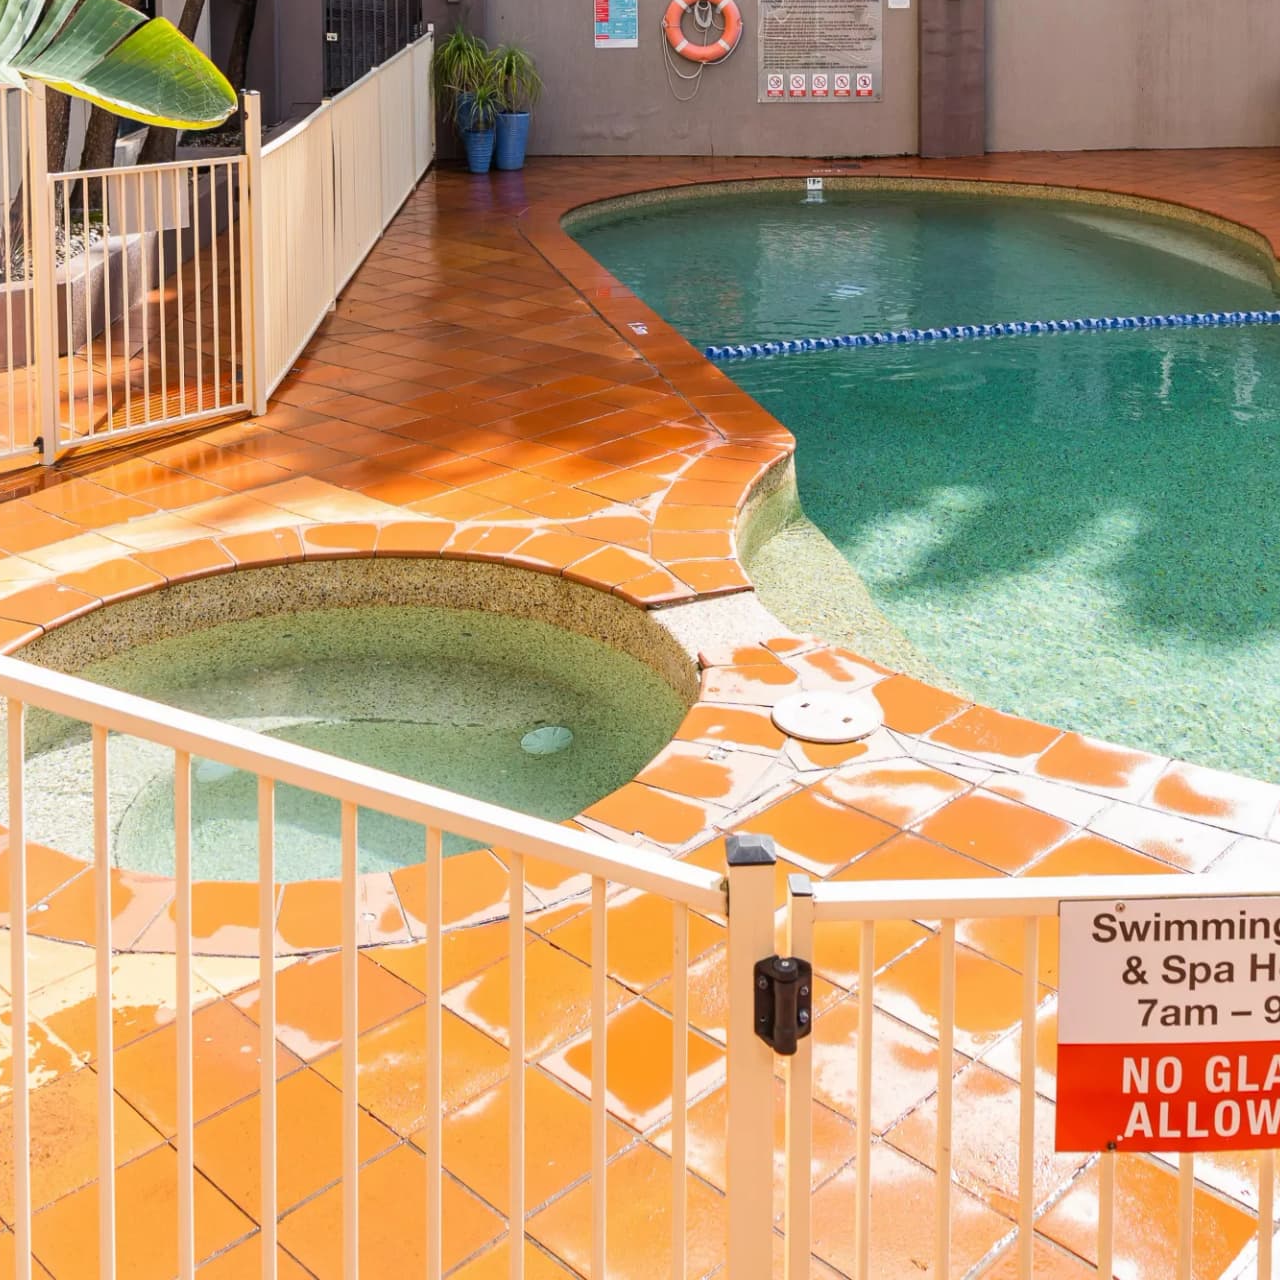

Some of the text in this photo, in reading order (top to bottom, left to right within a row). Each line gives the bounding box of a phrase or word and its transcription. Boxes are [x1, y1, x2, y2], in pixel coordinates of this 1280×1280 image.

[1121, 955, 1149, 986] &
[1161, 954, 1235, 990] Spa
[1137, 998, 1219, 1027] 7am
[1122, 1056, 1184, 1095] NO
